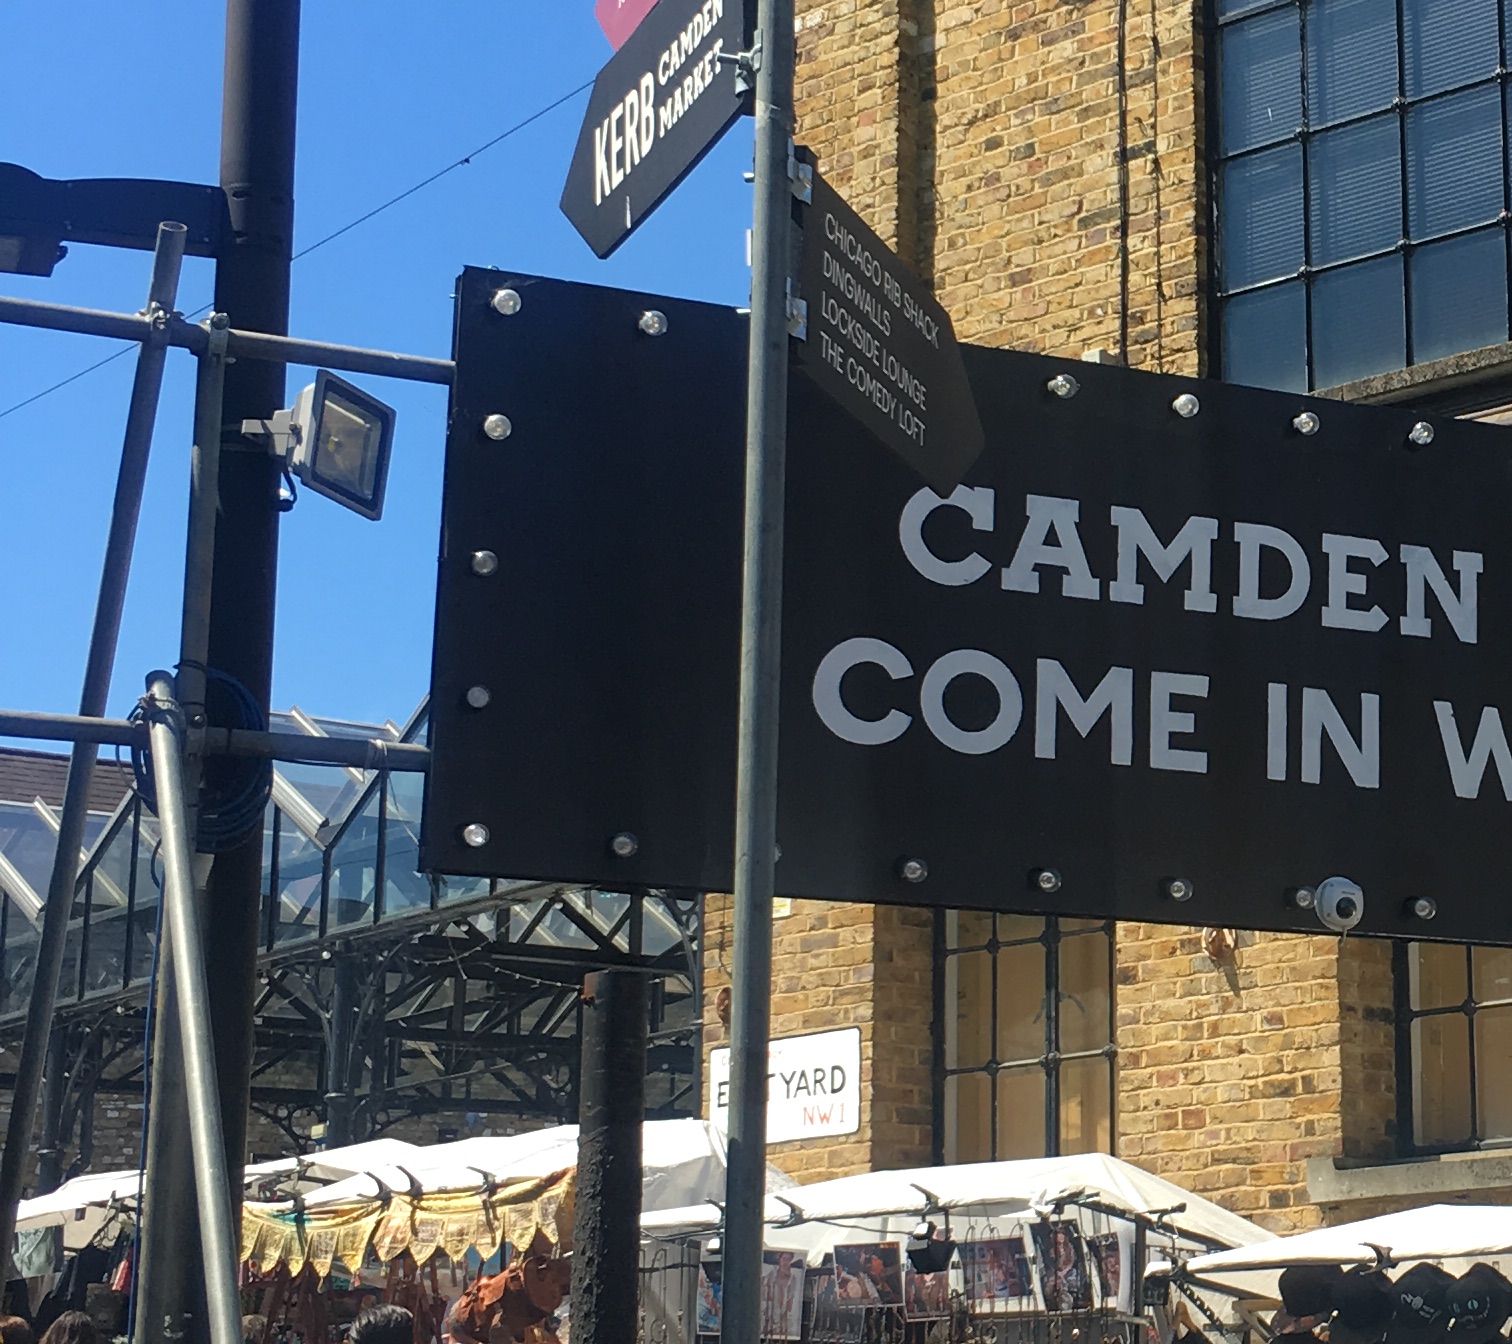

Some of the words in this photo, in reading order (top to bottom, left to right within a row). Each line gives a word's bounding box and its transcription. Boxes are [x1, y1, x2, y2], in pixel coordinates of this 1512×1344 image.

[594, 71, 655, 207] KERB
[658, 38, 724, 139] MARKET
[823, 250, 891, 337] DINGWALLS
[825, 212, 882, 287] CHICAGO
[883, 270, 902, 308] RIB
[903, 292, 940, 350] SHACK
[820, 330, 844, 374] THE
[846, 357, 897, 420] COMEDY
[898, 403, 926, 447] LOFT
[821, 290, 880, 367] LOCKSIDE
[882, 348, 927, 411] LOUNGE
[898, 483, 1483, 644] CAMDEN
[811, 636, 1210, 774] COME
[1266, 681, 1380, 788] IN
[779, 1064, 847, 1099] YARD
